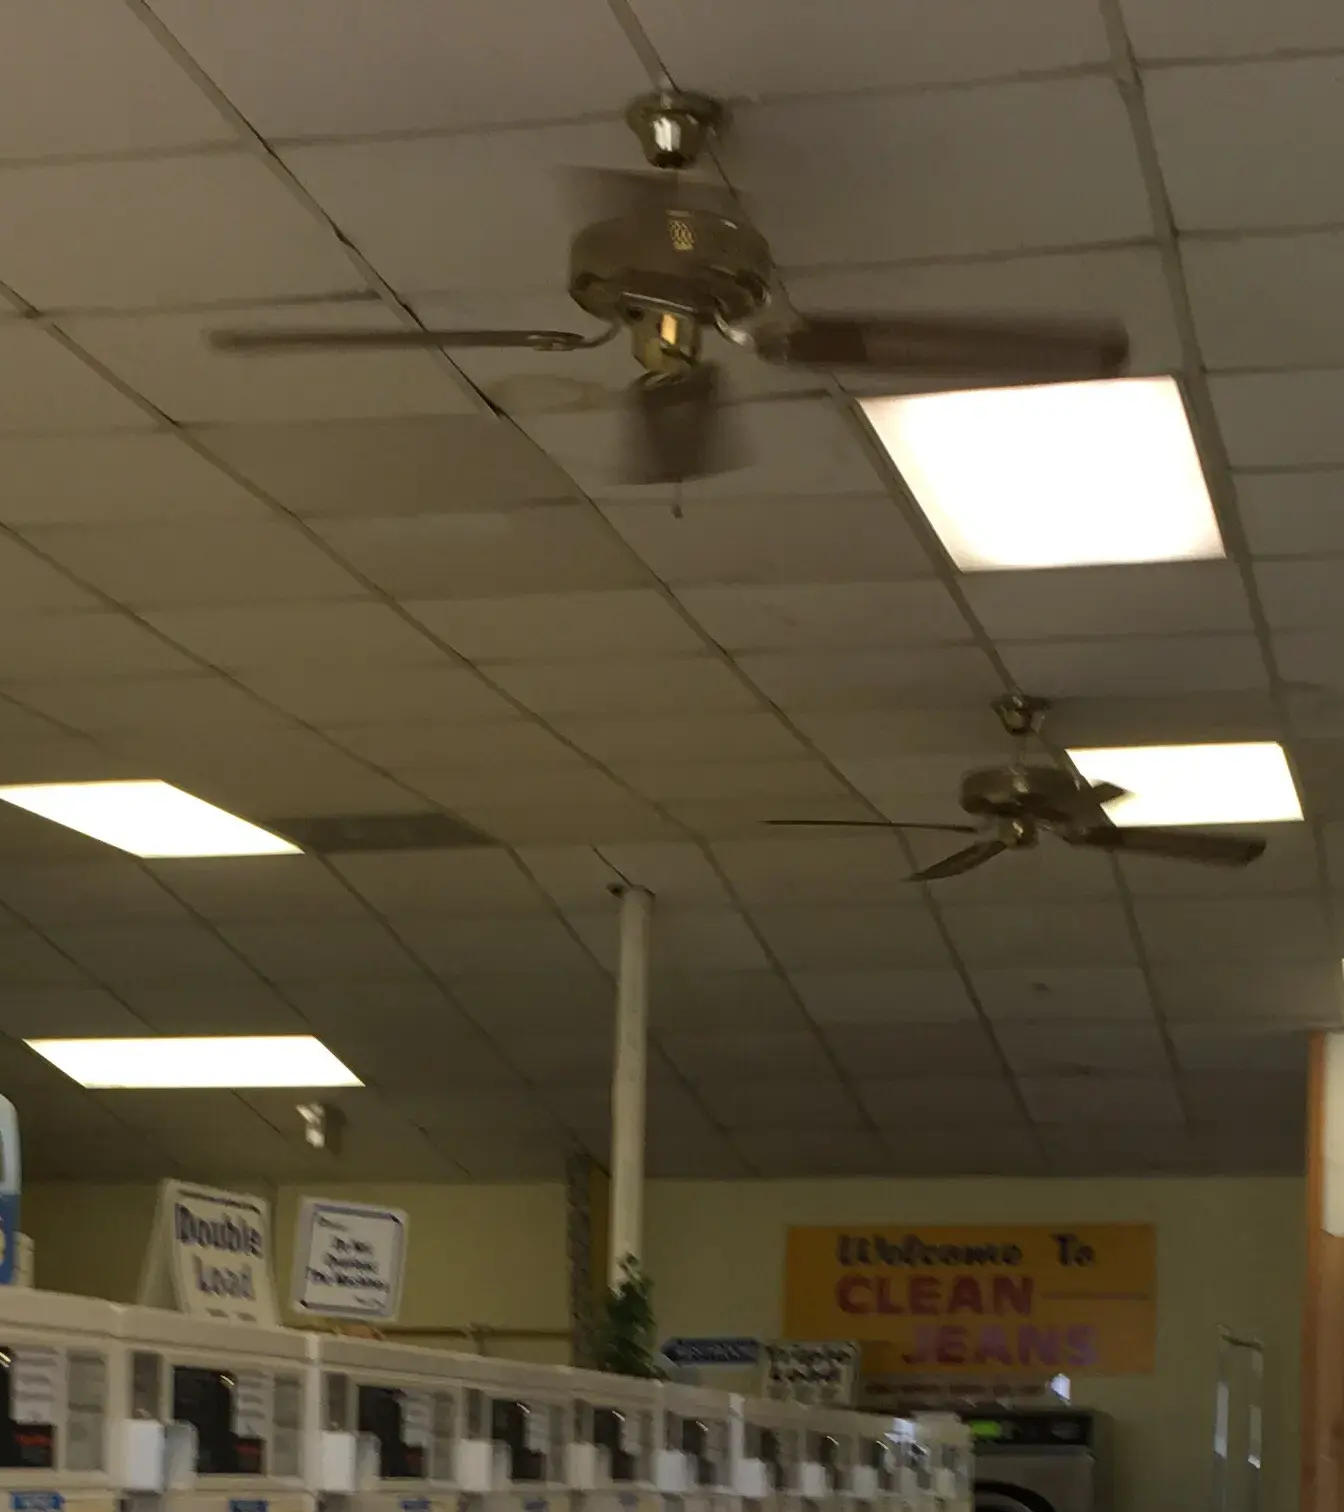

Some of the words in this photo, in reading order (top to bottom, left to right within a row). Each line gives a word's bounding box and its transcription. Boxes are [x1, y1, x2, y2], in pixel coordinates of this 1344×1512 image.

[174, 1202, 263, 1259] Double
[836, 1233, 1023, 1267] Welcome
[1050, 1232, 1096, 1267] To
[192, 1253, 256, 1300] Load
[835, 1274, 1035, 1317] CLEAN
[901, 1324, 1100, 1367] JEANS
